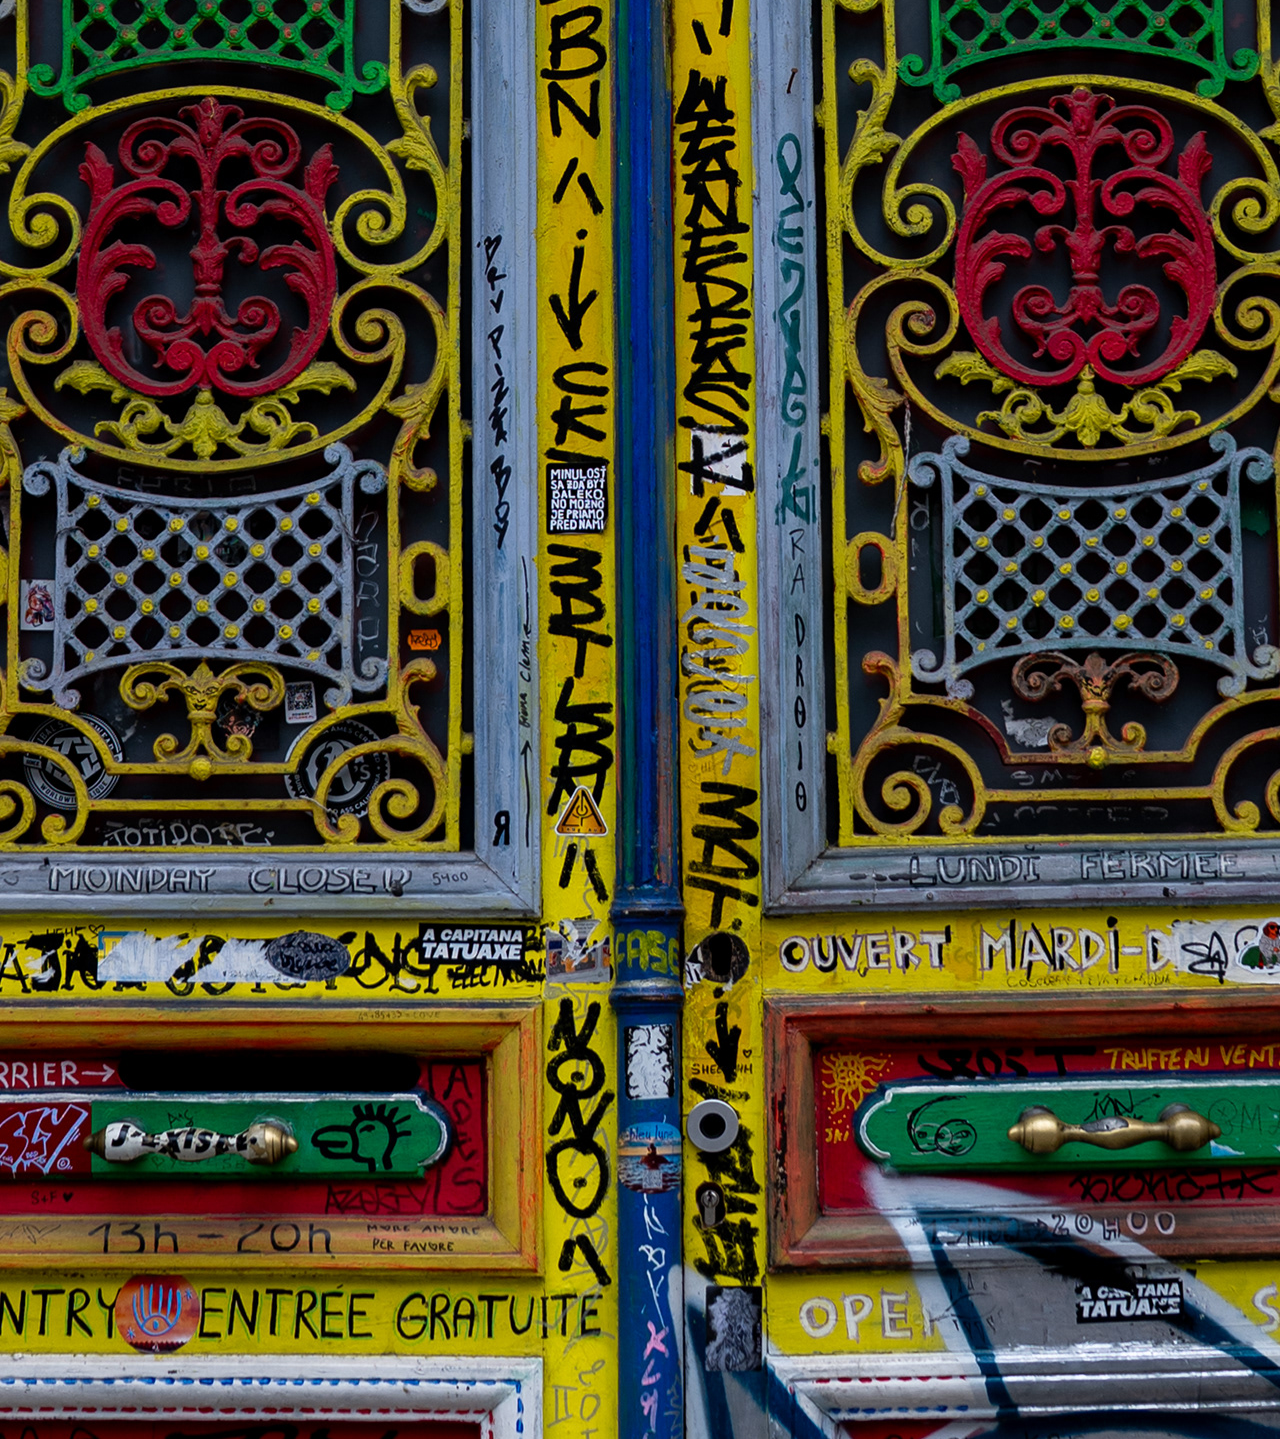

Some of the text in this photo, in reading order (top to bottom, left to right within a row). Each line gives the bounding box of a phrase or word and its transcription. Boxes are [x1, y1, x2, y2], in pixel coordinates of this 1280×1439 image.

[550, 509, 565, 520] JE
[551, 498, 567, 510] NO
[549, 519, 578, 532] PRED
[1080, 850, 1246, 880] FERMEE
[48, 867, 217, 895] MONDAY
[422, 928, 523, 943] A CAPITANA
[422, 942, 522, 961] TATUAXE
[779, 924, 951, 977] OUVERT
[89, 1222, 333, 1256] 13h 20h
[396, 1290, 602, 1343] GRATUITE
